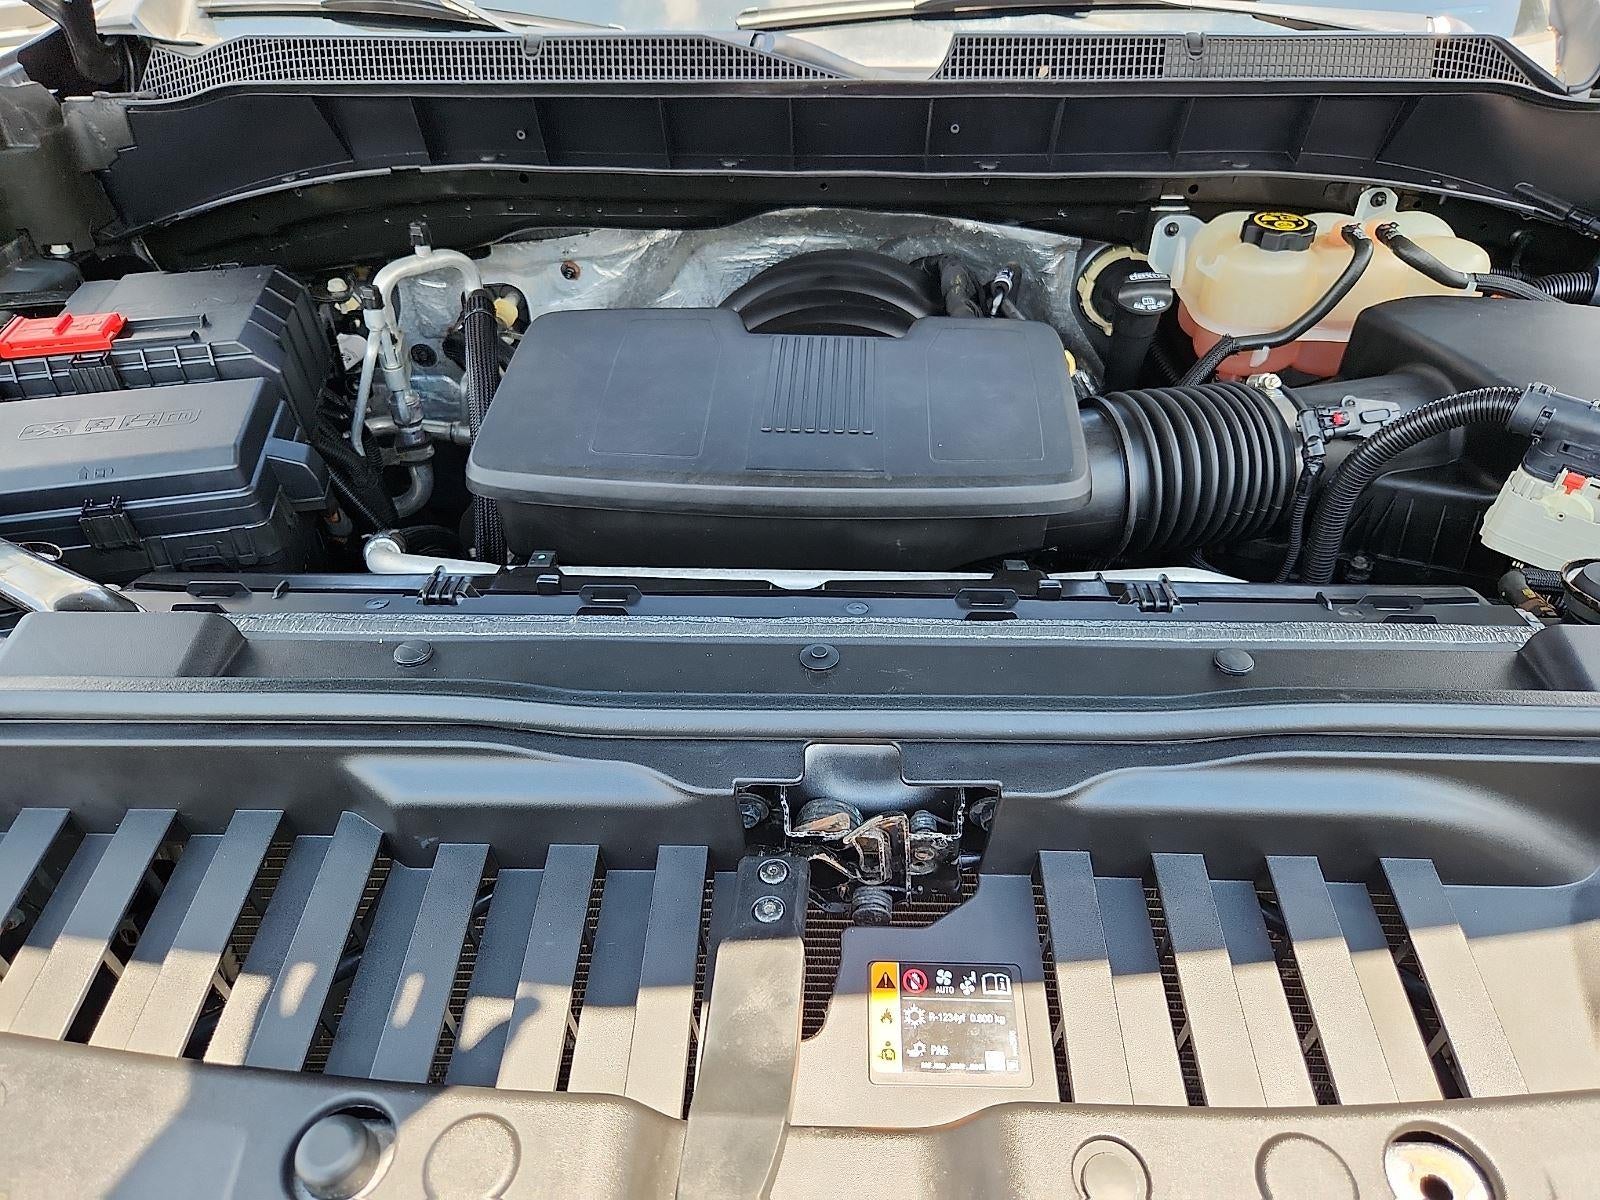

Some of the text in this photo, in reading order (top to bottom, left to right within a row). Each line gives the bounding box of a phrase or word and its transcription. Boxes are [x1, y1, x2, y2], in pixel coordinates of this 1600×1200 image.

[935, 986, 954, 995] AUTO
[928, 1012, 966, 1024] R-1234yf
[994, 1013, 1006, 1025] kg
[930, 1045, 949, 1056] PAG
